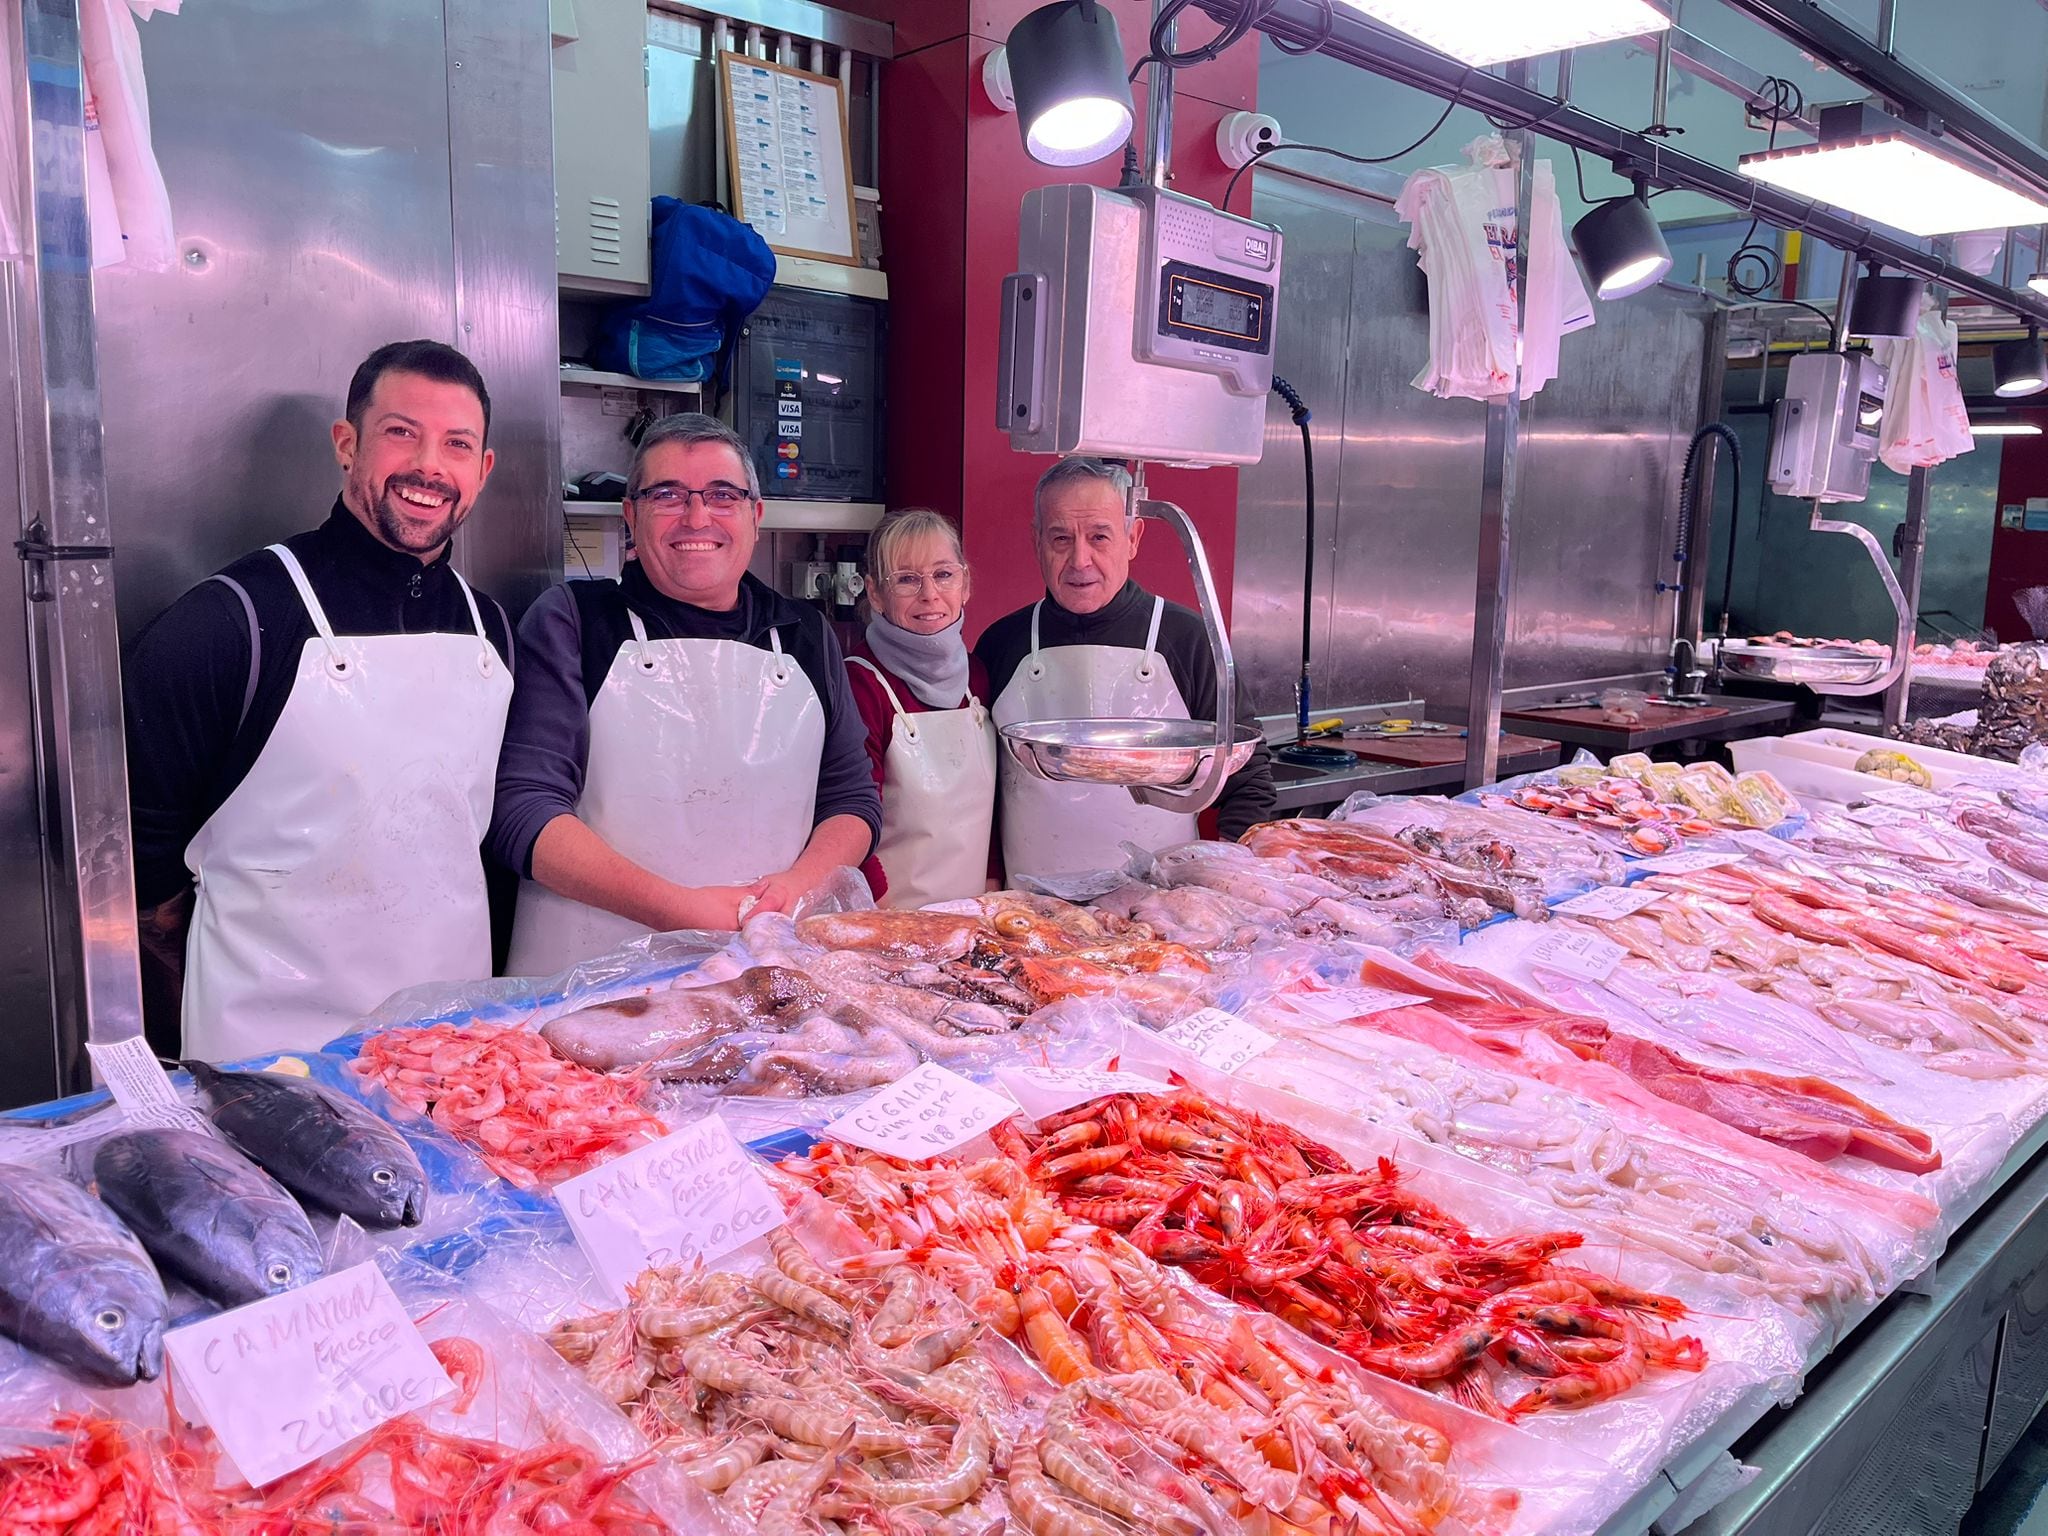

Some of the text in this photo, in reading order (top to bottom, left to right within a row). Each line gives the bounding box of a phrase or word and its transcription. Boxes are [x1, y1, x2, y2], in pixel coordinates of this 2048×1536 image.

[1245, 238, 1267, 255] DIBAL
[781, 404, 800, 414] VISA
[781, 425, 800, 434] VISA
